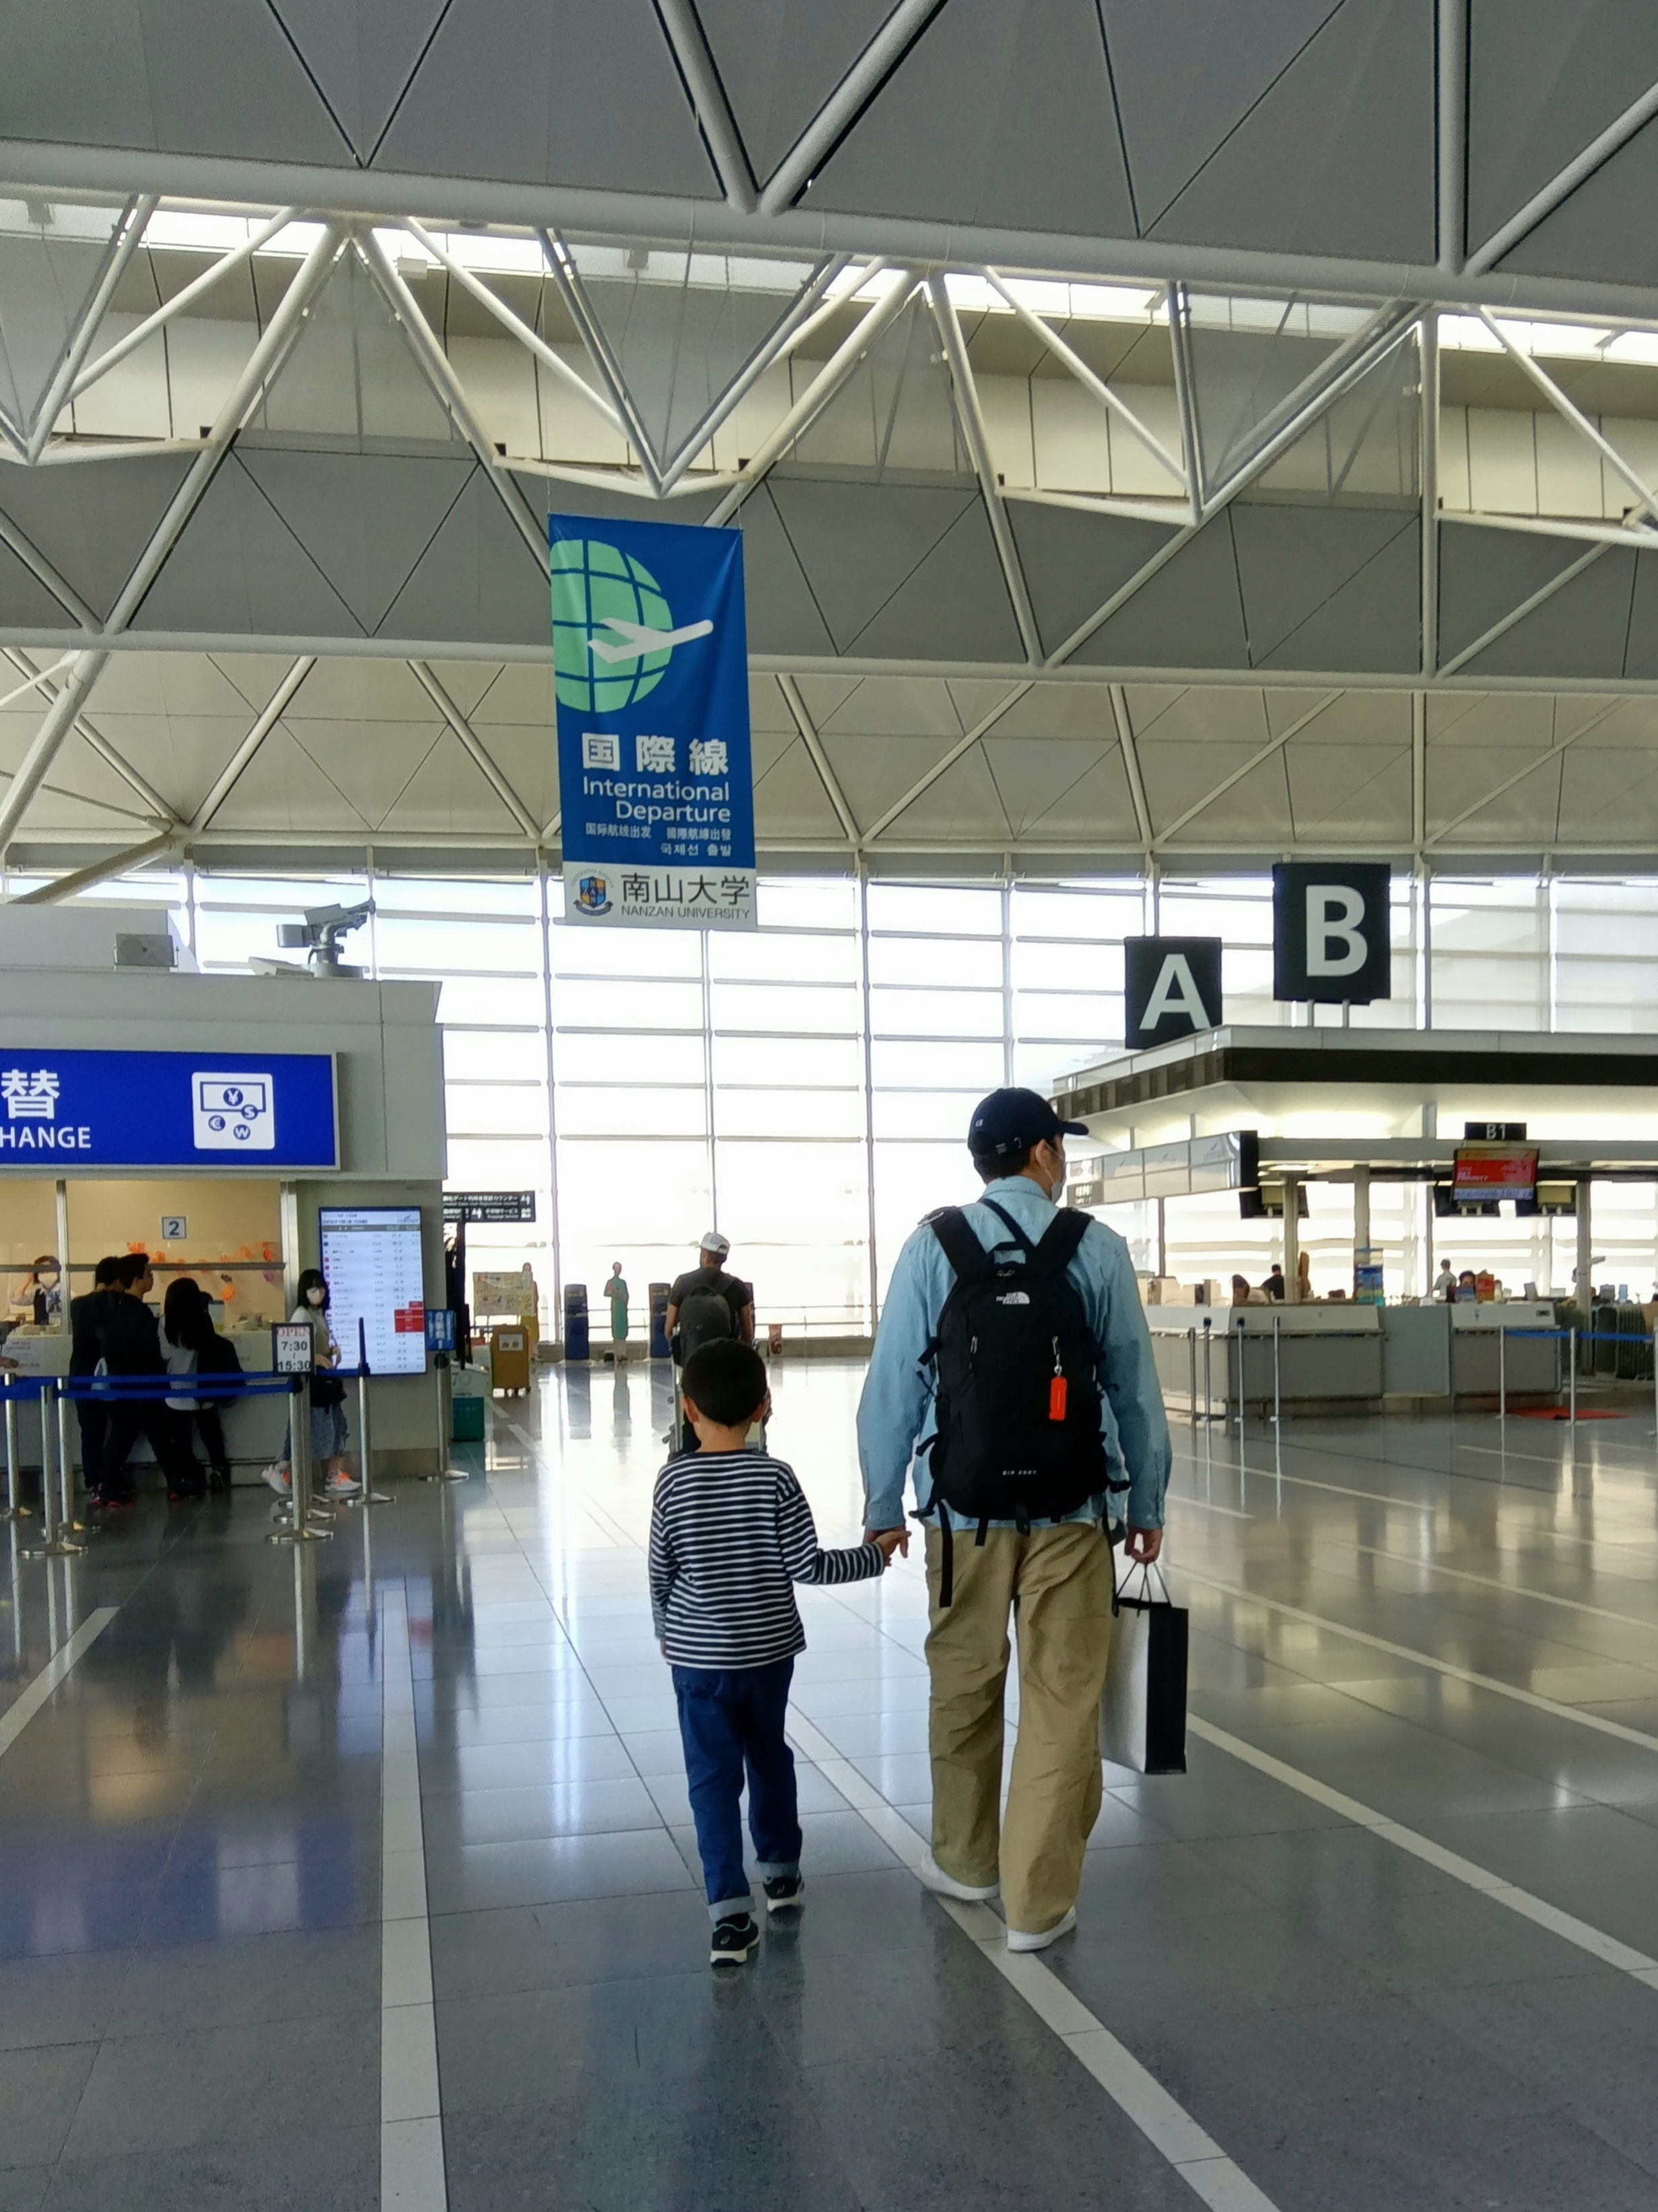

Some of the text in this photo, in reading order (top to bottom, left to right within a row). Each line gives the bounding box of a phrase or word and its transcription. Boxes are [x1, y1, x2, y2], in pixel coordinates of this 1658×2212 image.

[582, 733, 728, 776] 国際線
[583, 776, 729, 801] International
[615, 801, 731, 824] Departure
[585, 822, 652, 839] 国际航线出发
[660, 842, 732, 857] 국제선 출발
[621, 872, 750, 906] 南山大学
[621, 906, 750, 920] NANZAN UNIVERSITY
[1306, 885, 1368, 976] B
[1138, 953, 1212, 1030] A
[1, 1069, 60, 1119] 替
[0, 1126, 92, 1149] HANGE
[1486, 1123, 1506, 1139] B1
[169, 1221, 180, 1236] 2
[276, 1327, 310, 1337] OPEN
[281, 1341, 308, 1351] 7:30
[278, 1360, 311, 1371] 15:30
